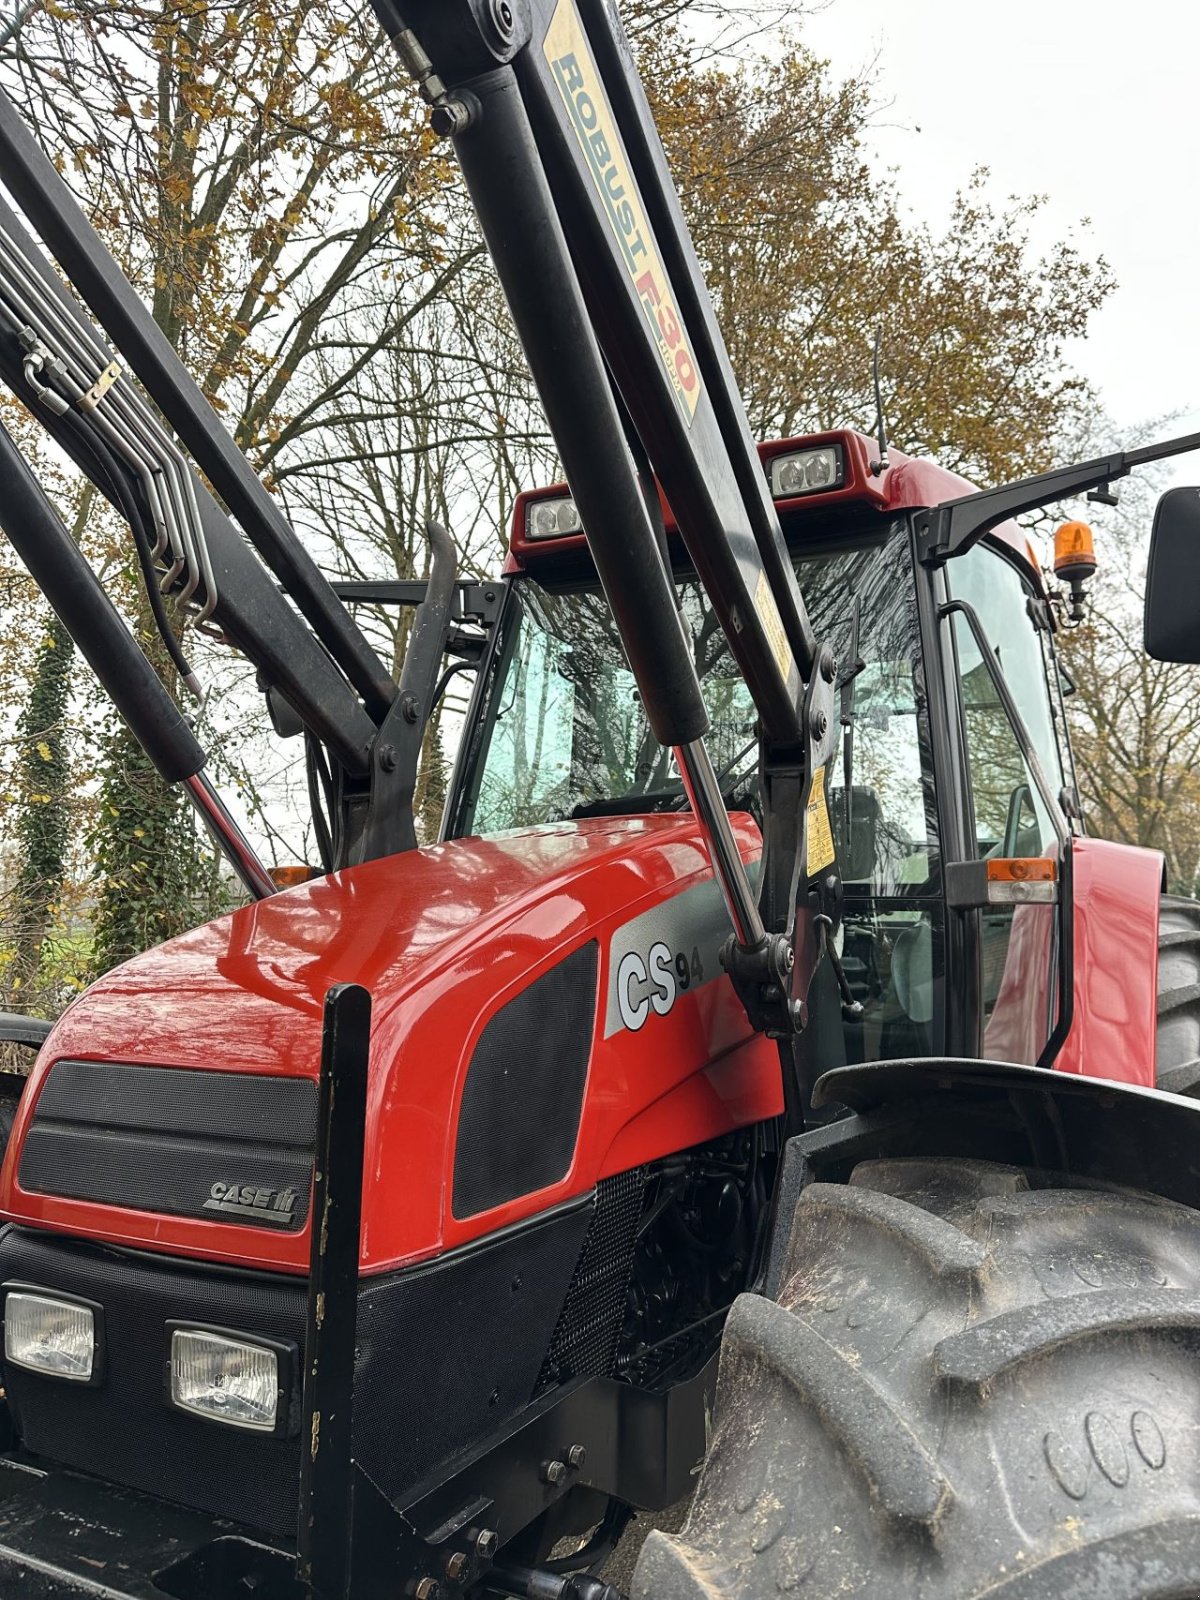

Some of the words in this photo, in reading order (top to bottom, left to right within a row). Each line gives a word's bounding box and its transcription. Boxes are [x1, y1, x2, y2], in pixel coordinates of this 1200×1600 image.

[560, 53, 647, 261] ROBUST
[636, 270, 697, 392] F30
[210, 1182, 273, 1208] CASE
